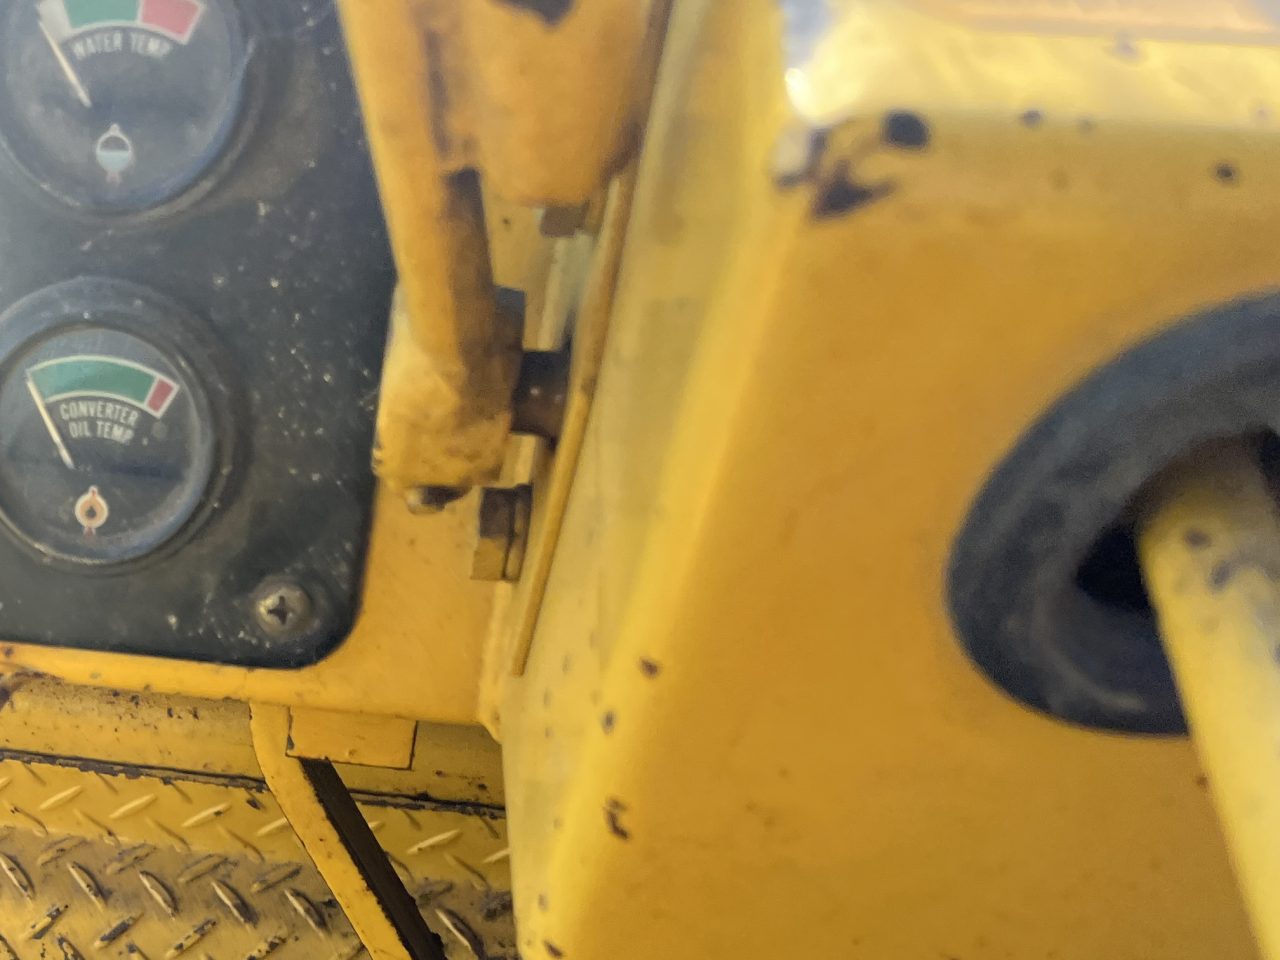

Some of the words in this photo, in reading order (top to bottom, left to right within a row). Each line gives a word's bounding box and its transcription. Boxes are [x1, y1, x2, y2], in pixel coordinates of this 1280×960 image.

[73, 31, 122, 60] WATER
[60, 400, 139, 426] CONVERTER
[69, 422, 91, 439] OIL
[96, 421, 134, 446] TEMP
